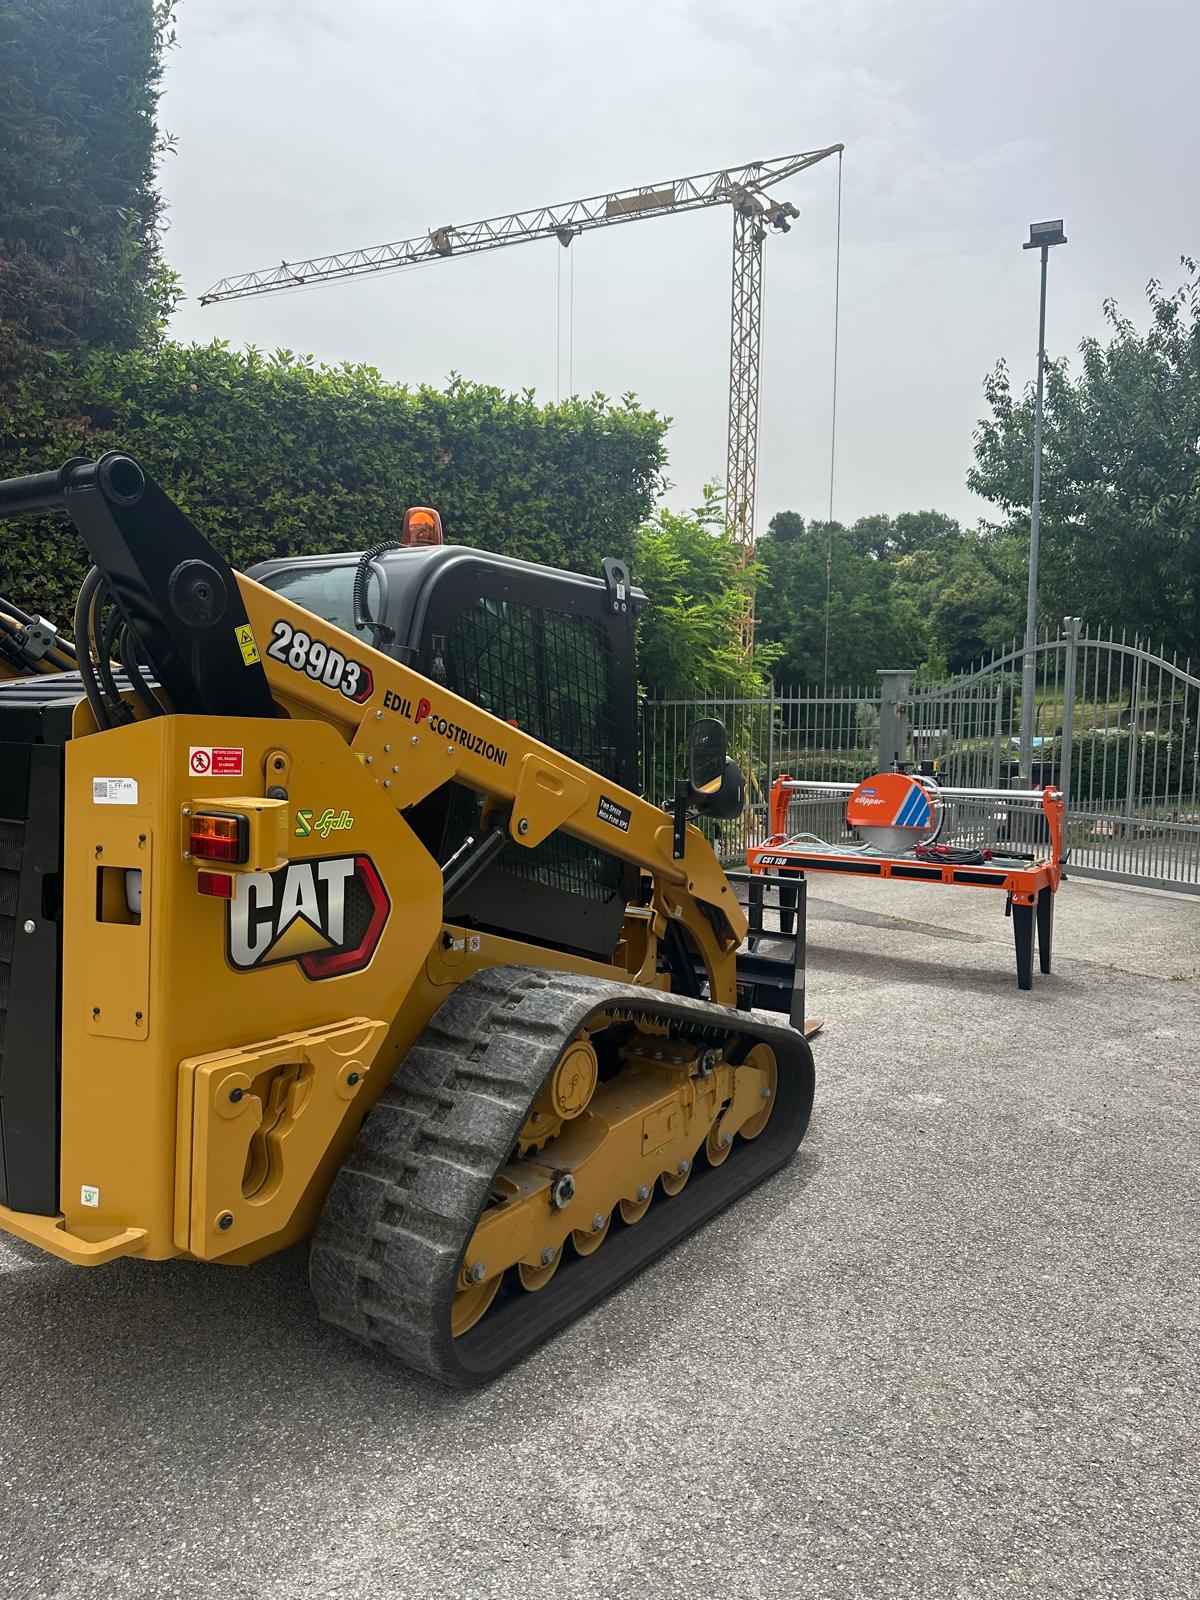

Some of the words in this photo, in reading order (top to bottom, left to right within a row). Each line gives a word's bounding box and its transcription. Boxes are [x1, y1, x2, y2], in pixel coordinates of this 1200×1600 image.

[267, 620, 363, 698] 289D3
[383, 690, 412, 720] EDIL
[414, 697, 432, 725] P
[429, 714, 508, 767] COSTRUZIONI
[854, 796, 884, 806] clipper
[761, 856, 775, 864] CST
[774, 858, 787, 866] 150
[230, 857, 355, 967] CAT
